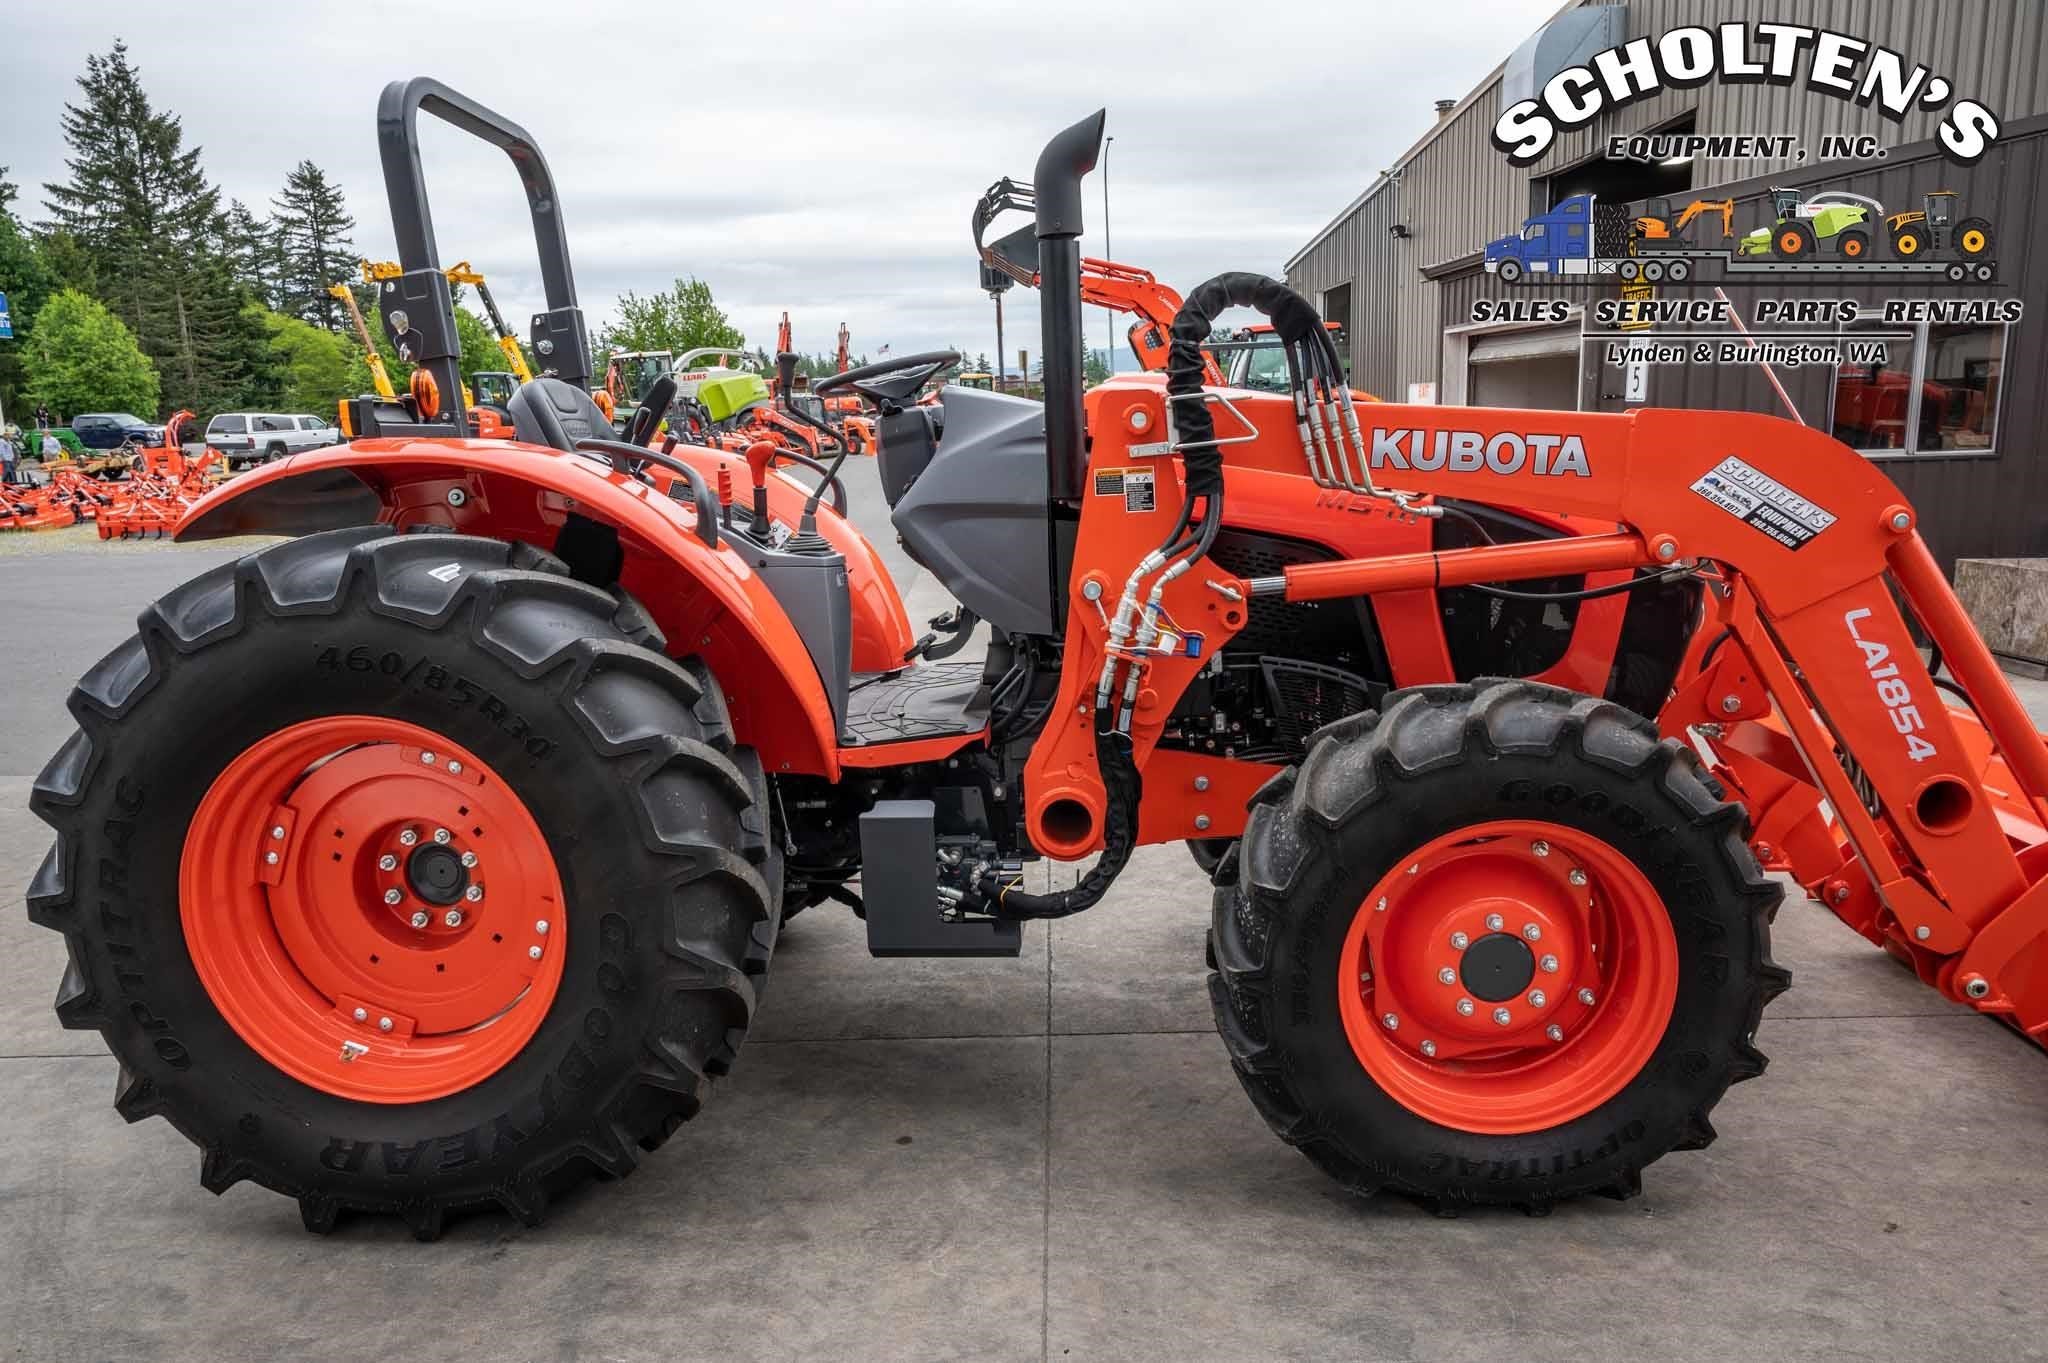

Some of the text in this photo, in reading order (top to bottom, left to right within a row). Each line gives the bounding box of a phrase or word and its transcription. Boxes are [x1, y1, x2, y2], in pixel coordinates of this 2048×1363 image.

[1632, 366, 1641, 393] 5
[1370, 427, 1592, 477] KUBOTA
[1720, 460, 1830, 529] SCHOLTEN'S
[1755, 505, 1815, 541] EQUIPMENT
[1845, 607, 1937, 762] LA1854
